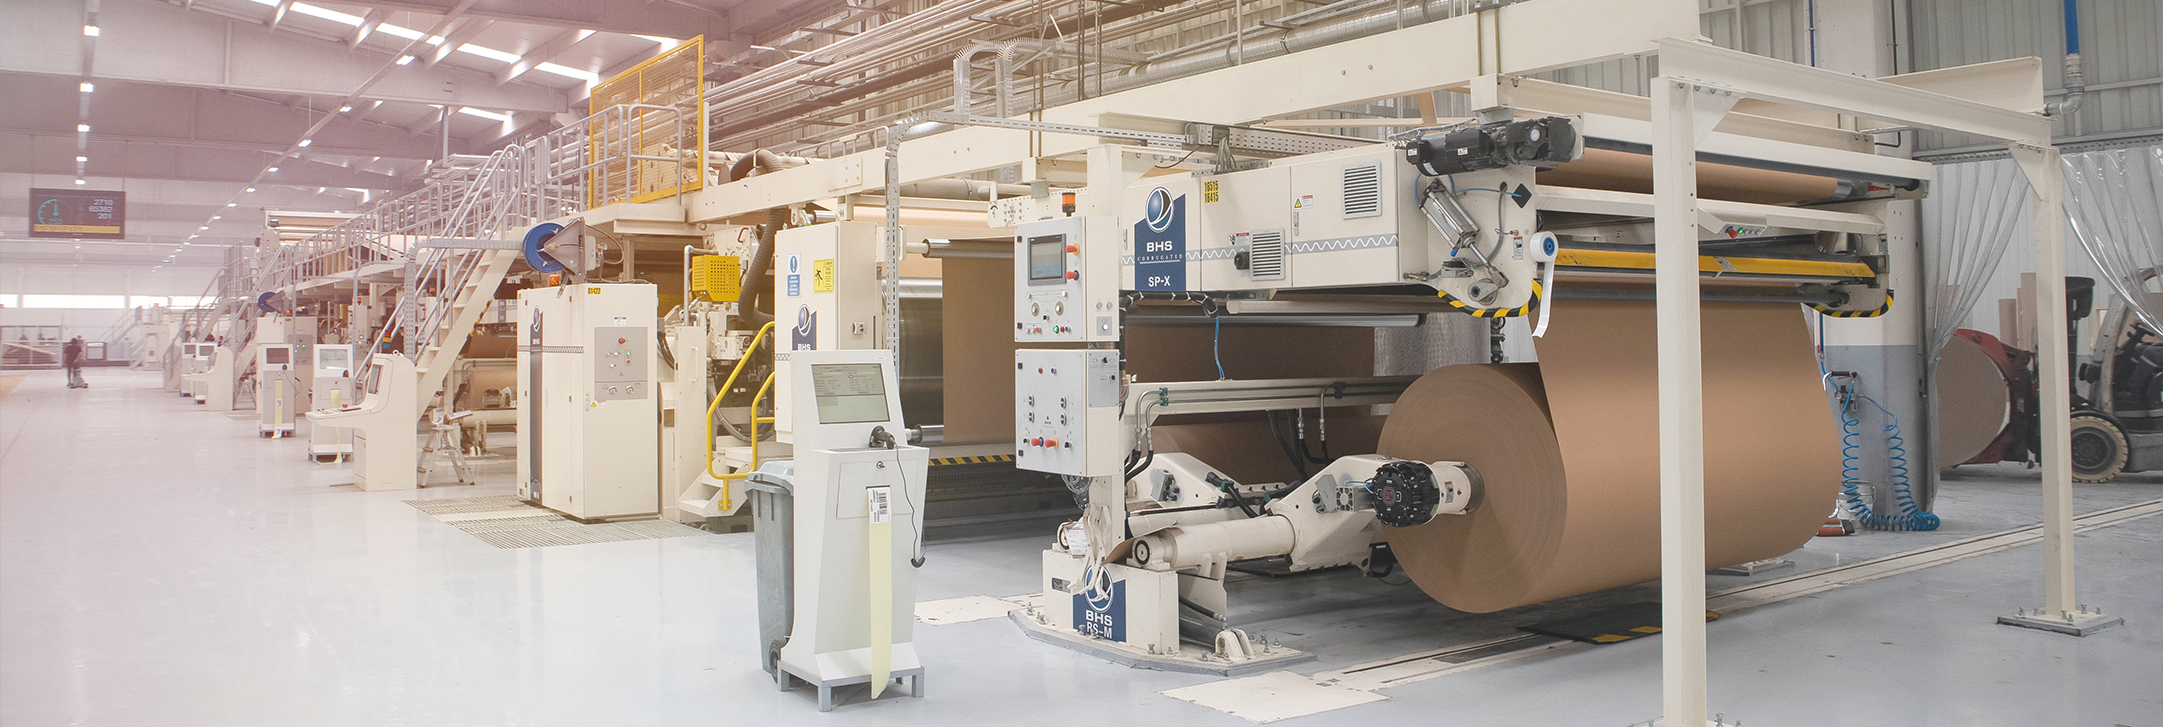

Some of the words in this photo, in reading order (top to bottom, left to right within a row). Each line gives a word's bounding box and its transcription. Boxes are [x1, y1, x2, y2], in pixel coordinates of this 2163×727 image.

[1204, 181, 1219, 192] 16515
[1204, 192, 1219, 203] 16415
[1146, 240, 1173, 252] BHS
[1137, 254, 1183, 262] CORRUGATED
[1148, 275, 1171, 287] SP-X
[797, 343, 811, 351] BHS
[1085, 609, 1113, 626] BHS
[1086, 622, 1113, 639] RS-M
